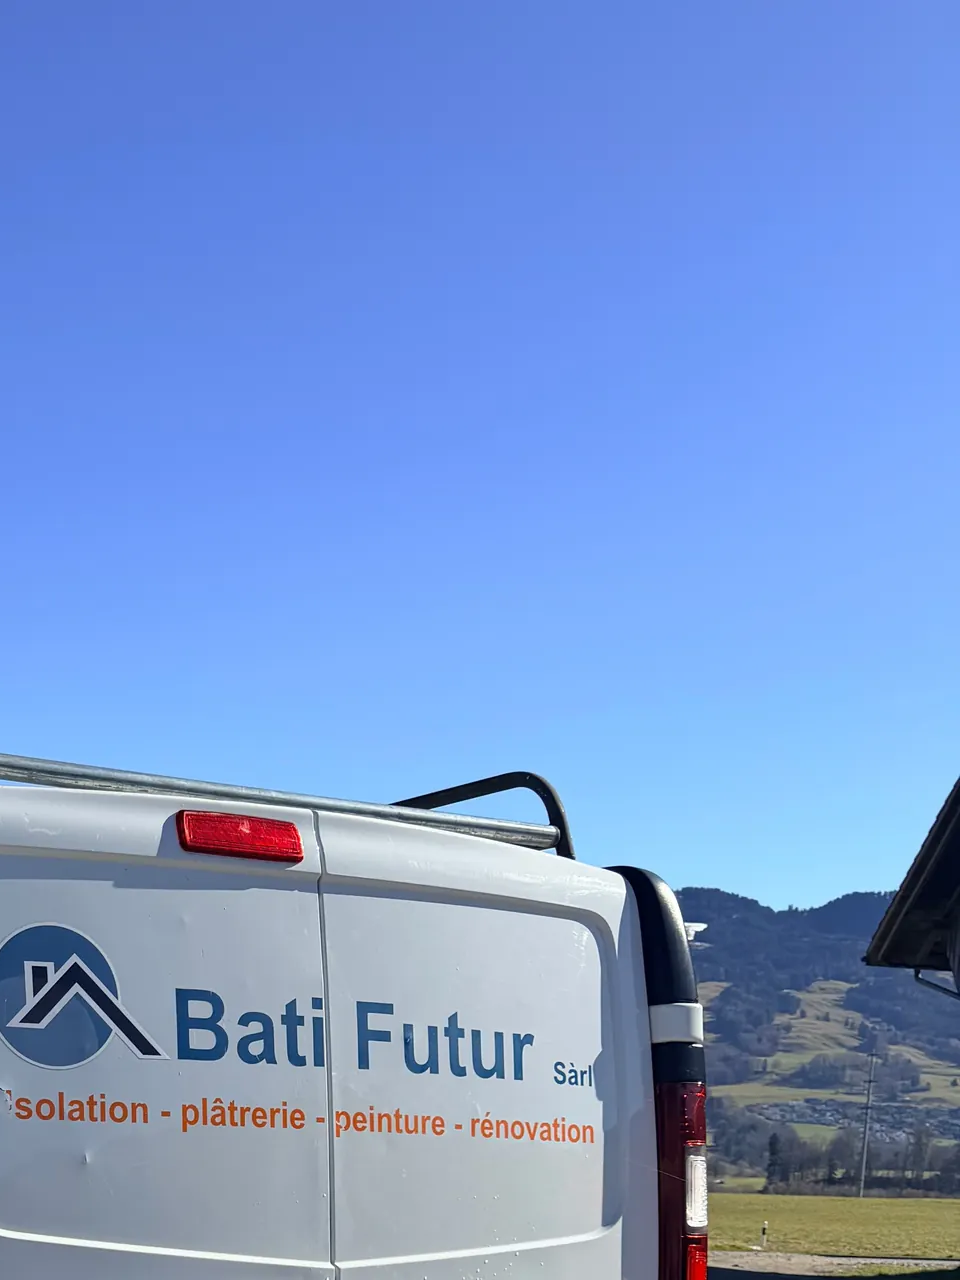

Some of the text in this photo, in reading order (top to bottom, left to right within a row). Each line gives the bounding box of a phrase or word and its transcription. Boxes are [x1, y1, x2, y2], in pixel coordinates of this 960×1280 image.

[175, 987, 592, 1087] Bati Futur Sàrl
[181, 1097, 306, 1132] plâtrerie
[335, 1106, 446, 1138] peinture
[470, 1112, 595, 1143] rénovation
